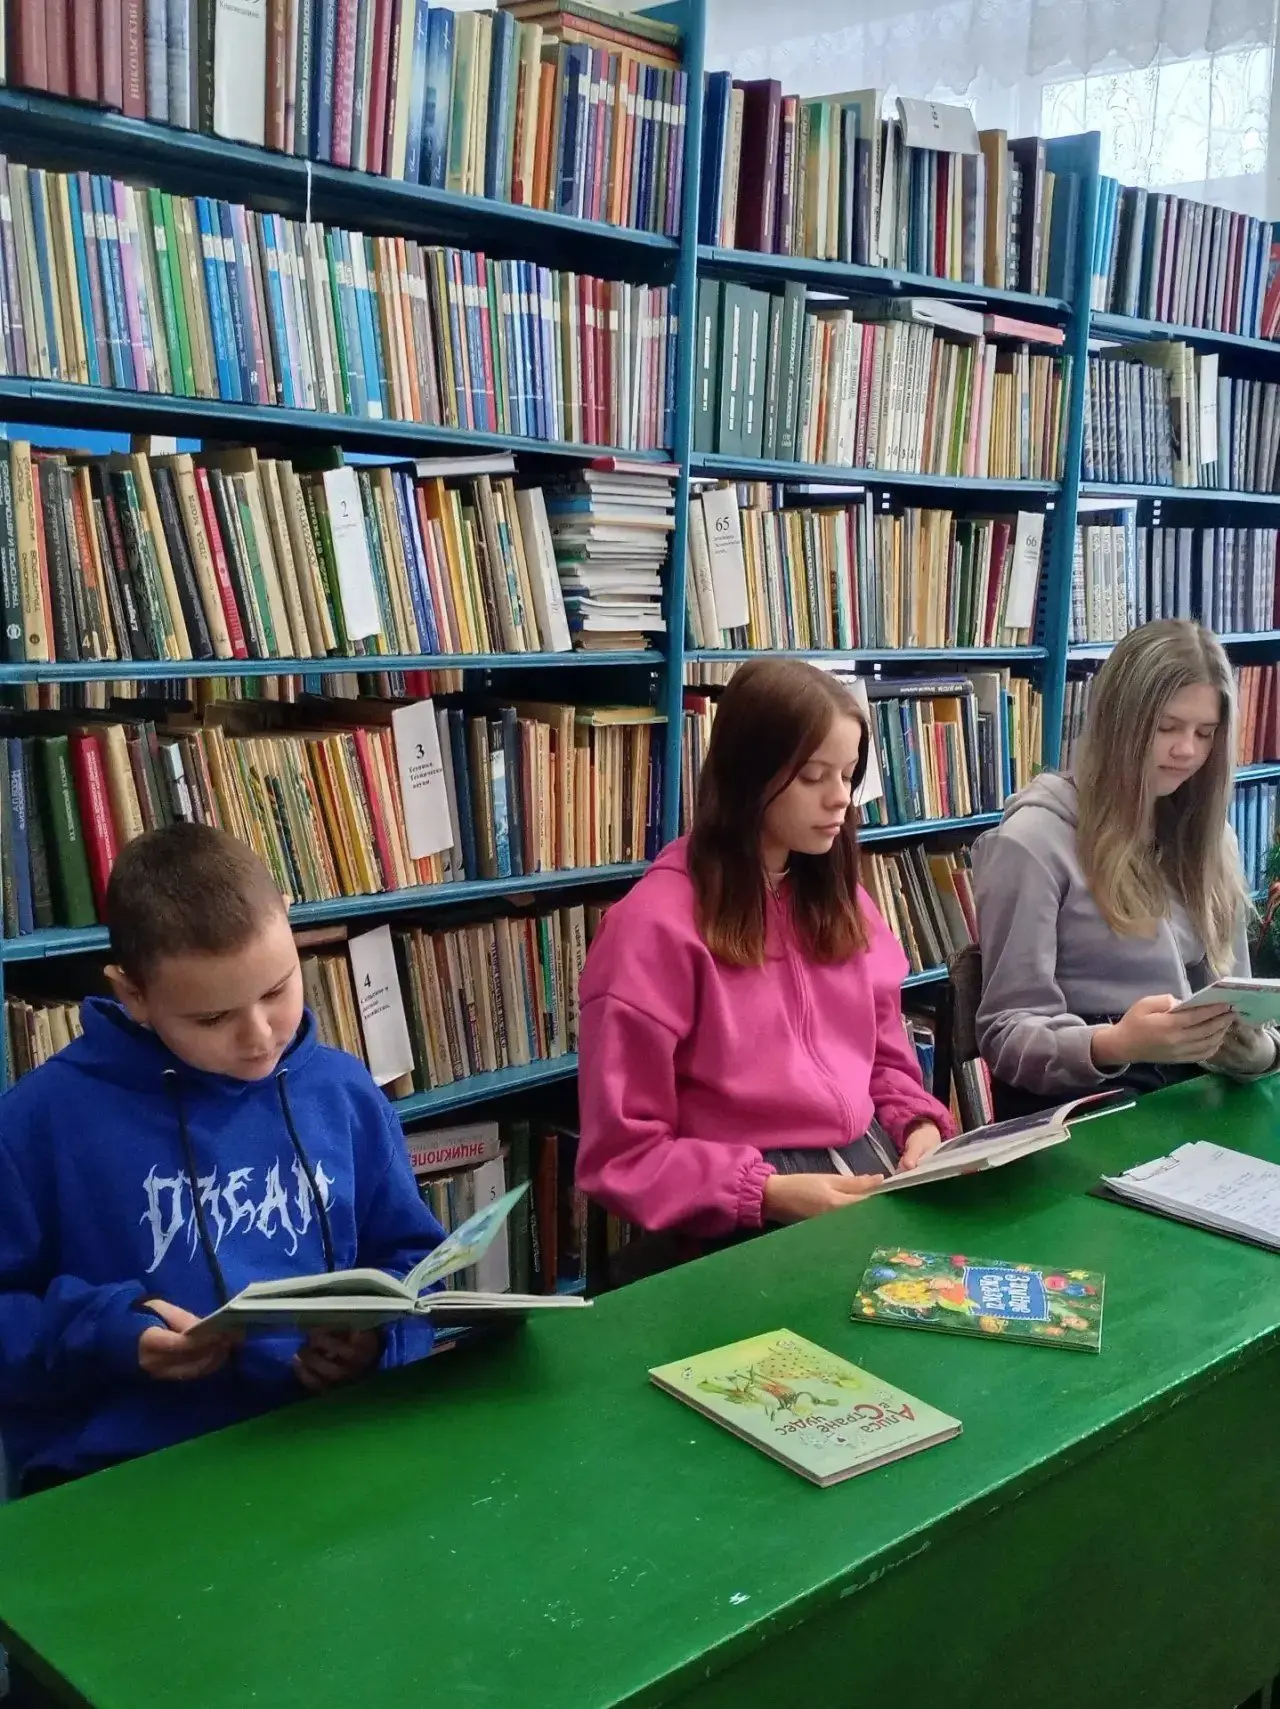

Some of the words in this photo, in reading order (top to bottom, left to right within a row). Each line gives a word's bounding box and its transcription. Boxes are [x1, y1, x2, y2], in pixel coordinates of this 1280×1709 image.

[340, 500, 349, 518] 2
[715, 516, 730, 532] 65
[1025, 534, 1037, 547] 66
[415, 743, 425, 759] 3
[364, 973, 371, 988] 4
[409, 1142, 485, 1168] ЭНЦИКЛОПЕ
[490, 1185, 497, 1201] 5
[774, 1414, 829, 1437] чудес
[816, 1403, 884, 1434] Стране
[860, 1402, 915, 1434] Алиса
